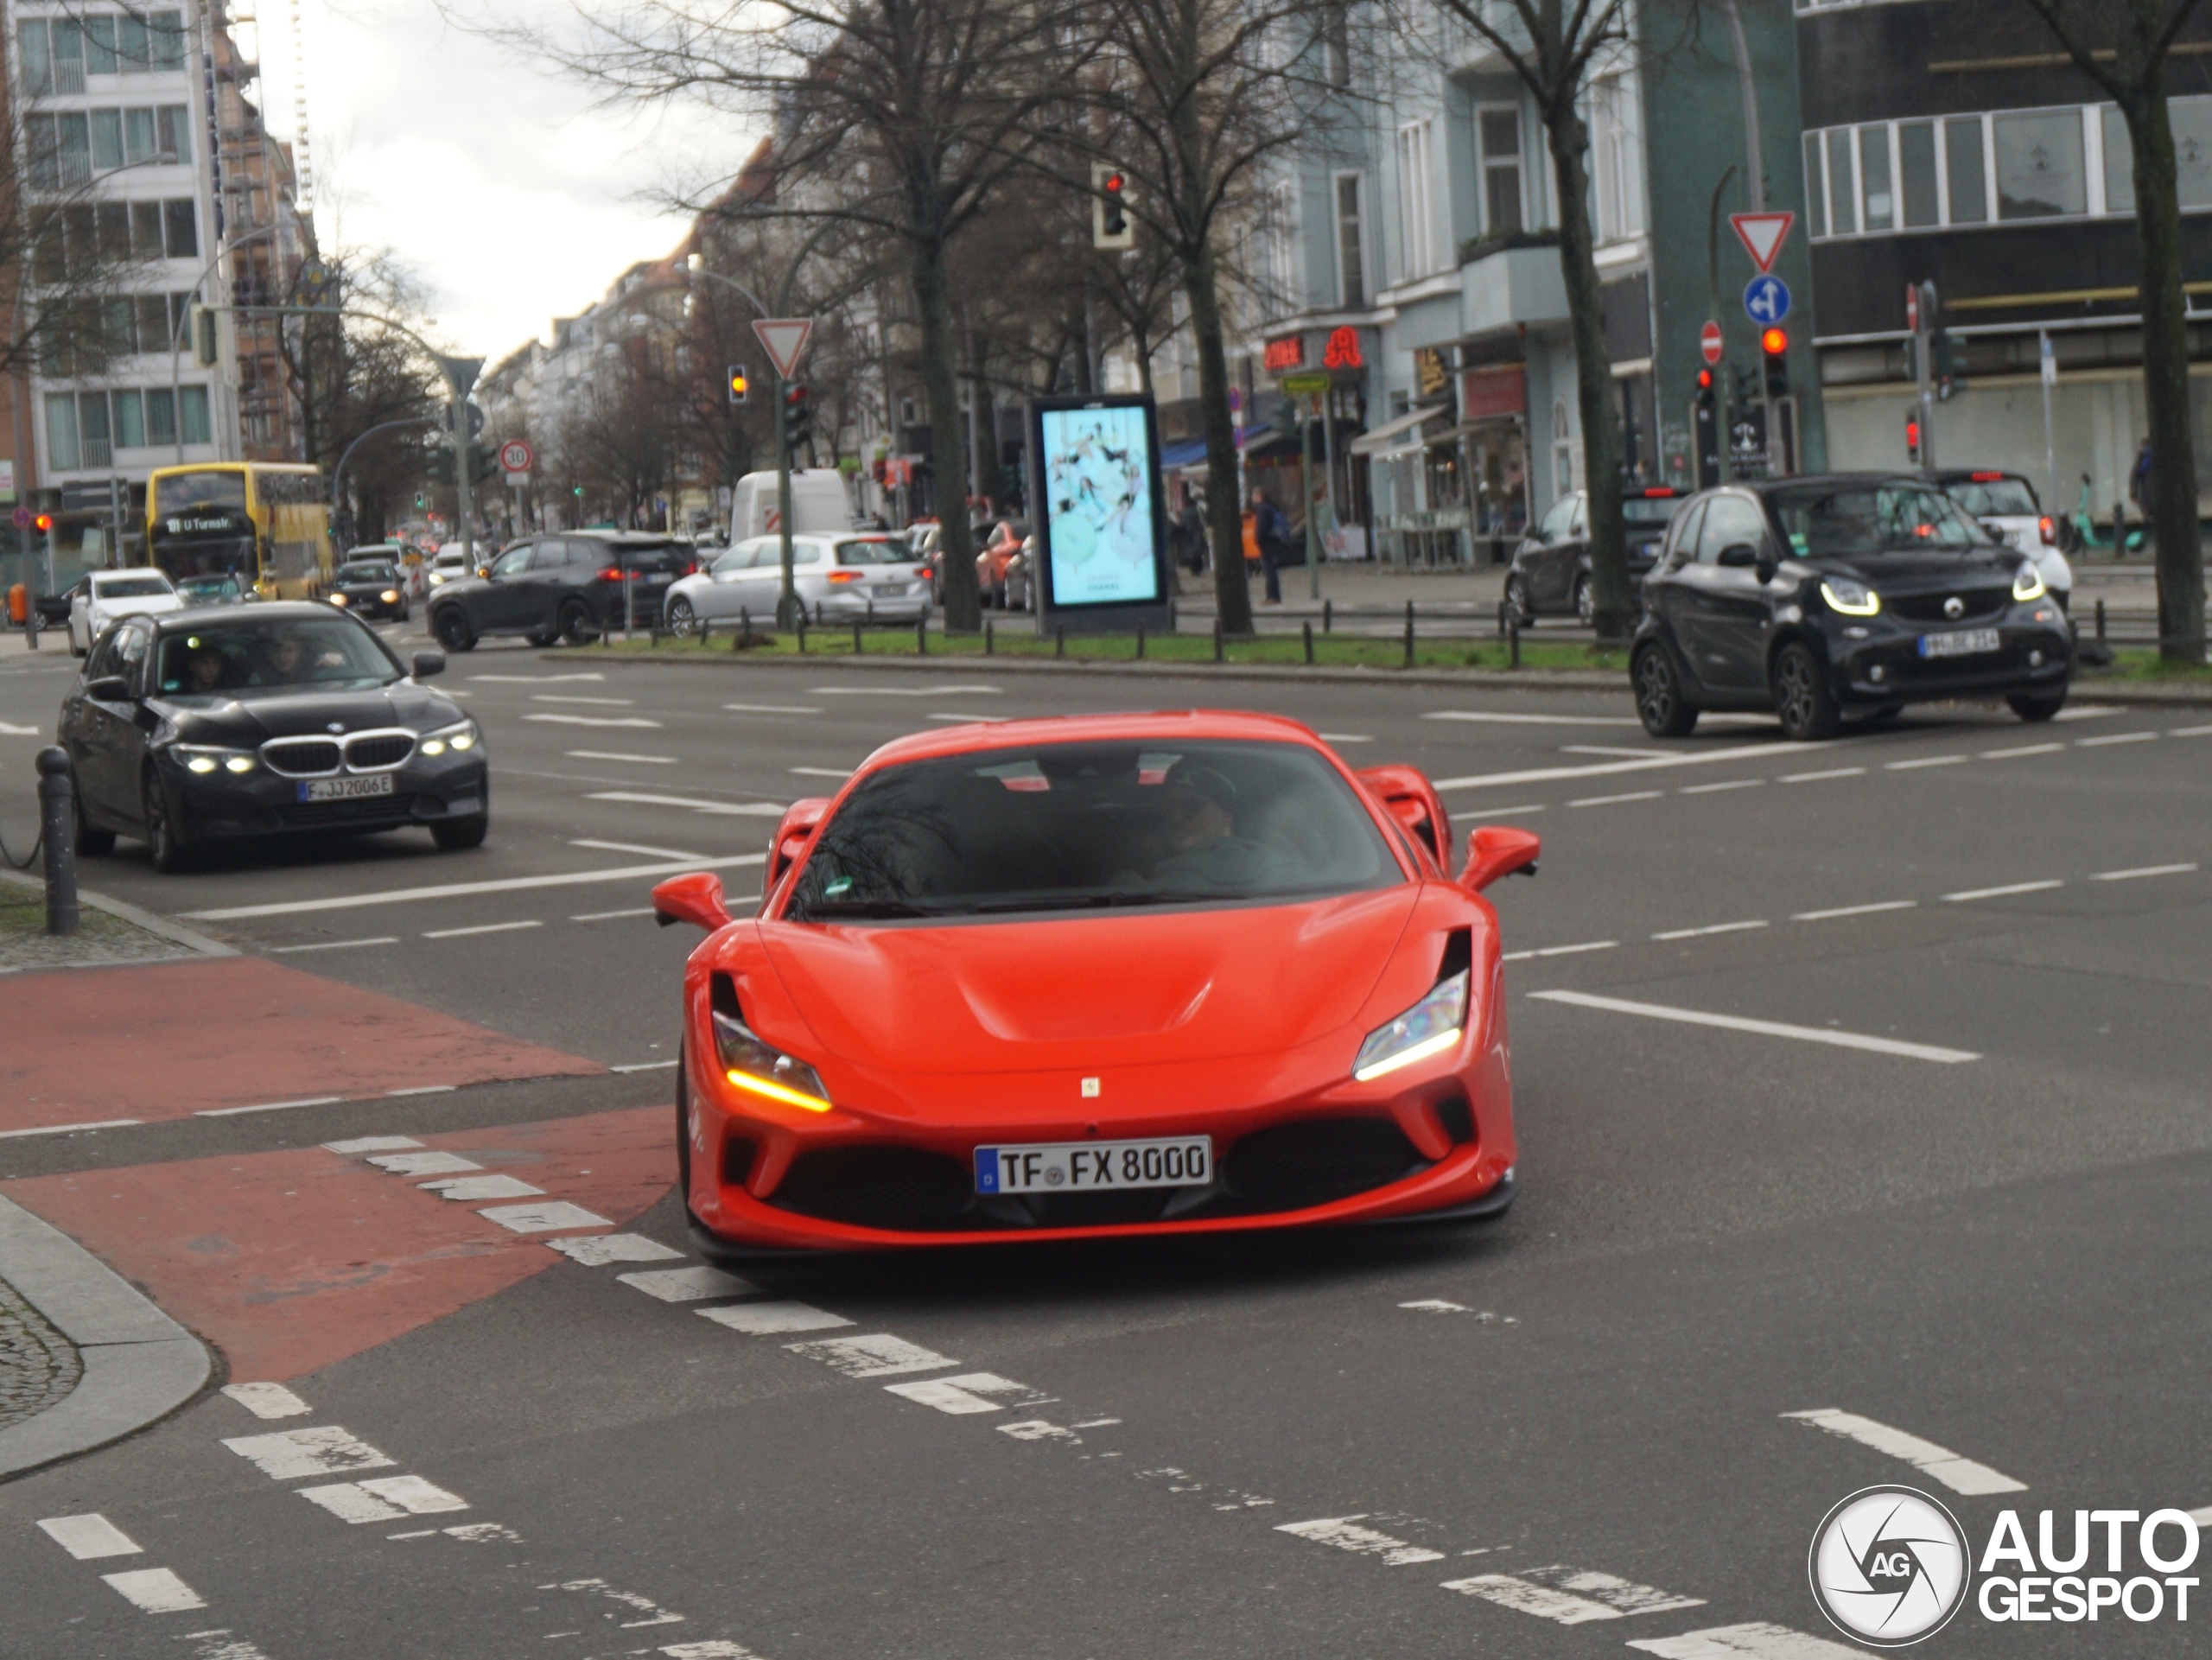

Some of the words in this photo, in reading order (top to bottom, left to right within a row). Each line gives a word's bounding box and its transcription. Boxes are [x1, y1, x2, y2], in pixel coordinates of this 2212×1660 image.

[506, 449, 525, 465] 30
[183, 519, 192, 531] U
[1000, 1153, 1043, 1186] TF
[1070, 1149, 1114, 1185] FX
[1122, 1145, 1205, 1182] 8000
